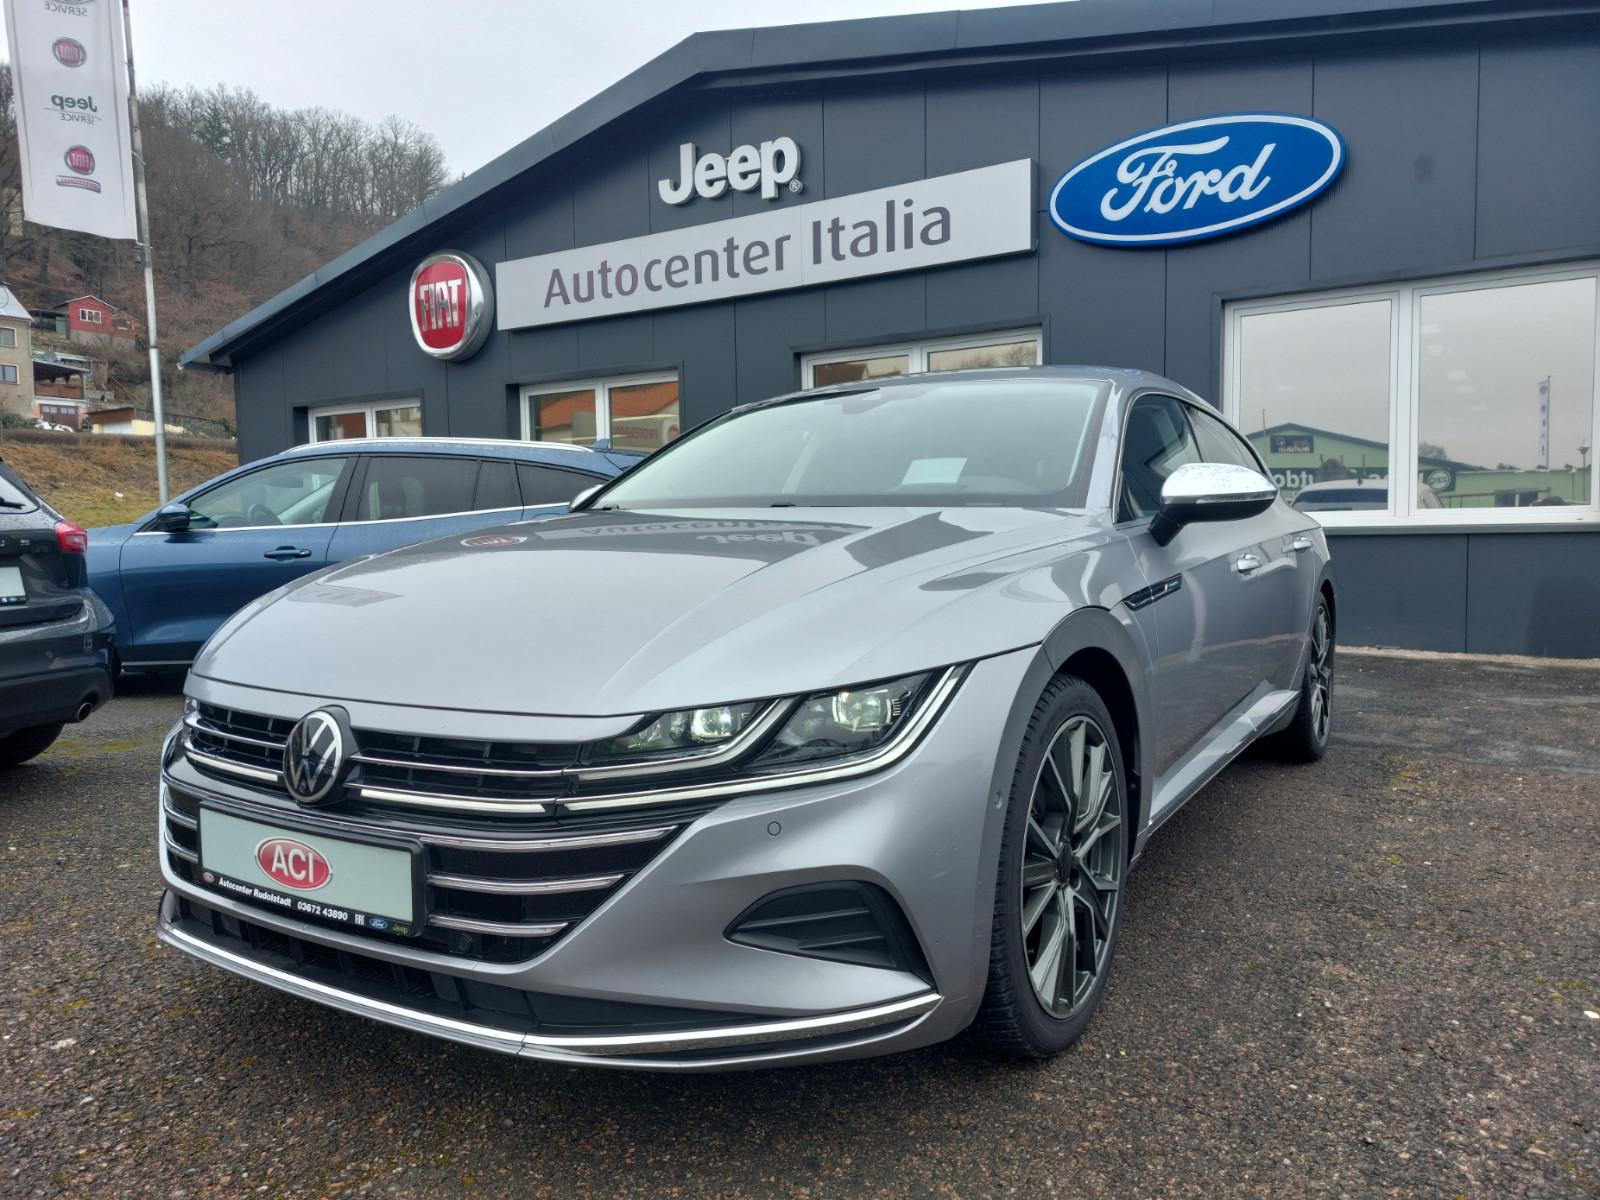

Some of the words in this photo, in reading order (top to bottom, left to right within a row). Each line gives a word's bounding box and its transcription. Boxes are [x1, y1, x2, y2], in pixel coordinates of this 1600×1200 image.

[658, 136, 800, 204] Jeep
[1100, 135, 1277, 222] Ford
[543, 234, 792, 308] Autocenter
[811, 198, 951, 265] Italia
[419, 278, 463, 332] FIAT
[271, 844, 316, 884] ACI
[218, 877, 253, 895] Autocenter
[253, 888, 292, 907] Rudolstadt
[297, 901, 321, 915] 03672
[322, 908, 348, 921] 43890
